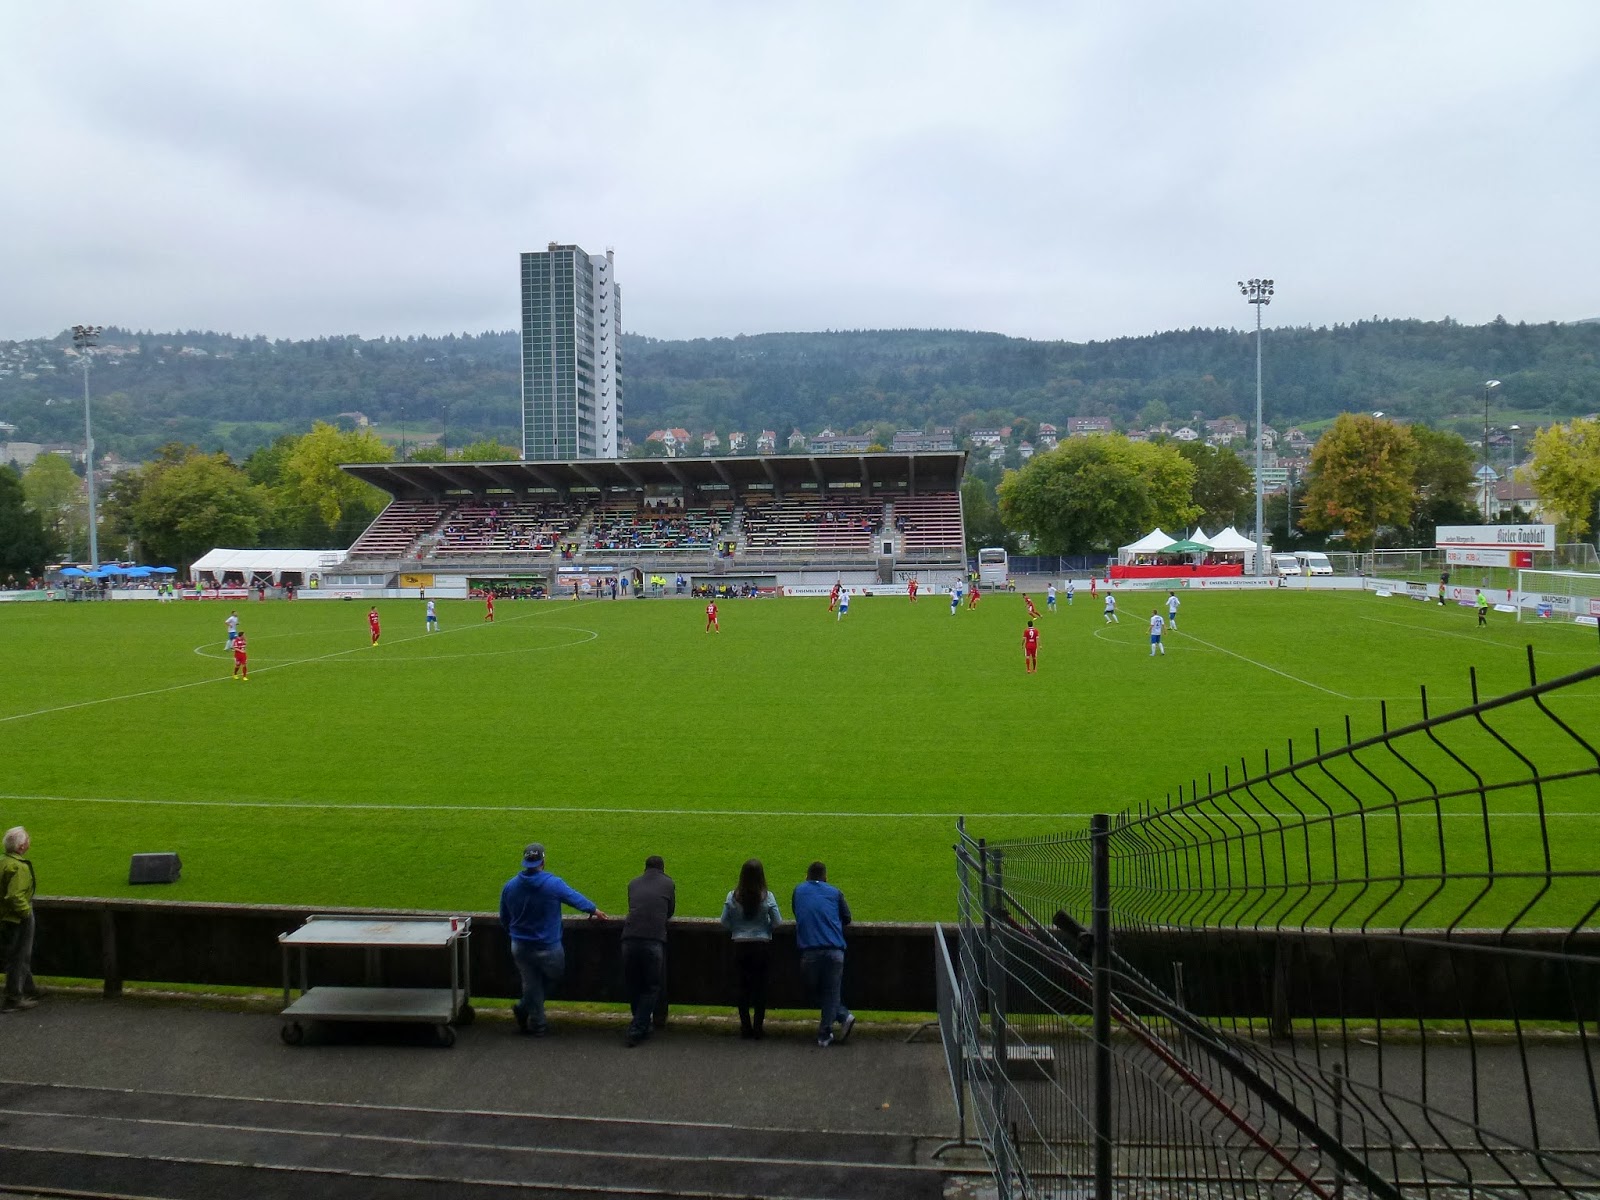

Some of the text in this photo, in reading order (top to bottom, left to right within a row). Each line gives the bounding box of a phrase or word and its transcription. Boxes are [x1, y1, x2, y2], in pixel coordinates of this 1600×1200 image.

[1497, 527, 1545, 543] Bieler Tagblatt
[1029, 630, 1034, 639] 9
